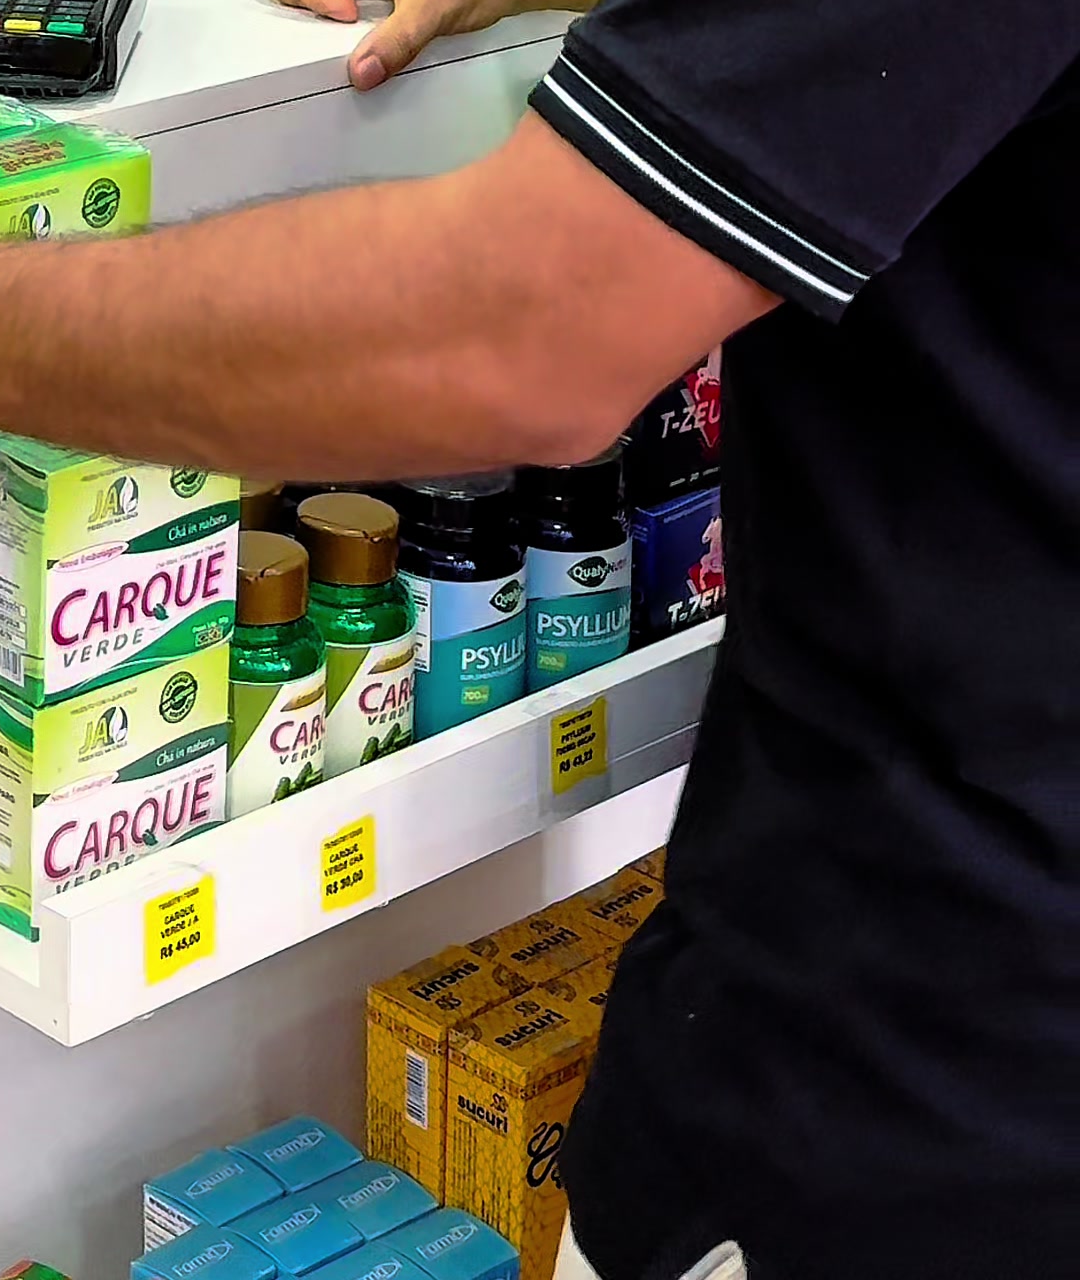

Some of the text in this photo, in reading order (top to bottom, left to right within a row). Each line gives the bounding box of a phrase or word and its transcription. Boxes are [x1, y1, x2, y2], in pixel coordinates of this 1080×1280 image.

[51, 550, 225, 647] CARQUE
[536, 603, 632, 638] PSYLLIUM
[62, 627, 145, 669] VERDE
[358, 674, 415, 716] CAR
[270, 713, 326, 755] CAR
[43, 772, 214, 880] CARQUE
[325, 880, 339, 897] R$
[160, 943, 174, 960] R$
[510, 926, 578, 964] sucuri
[494, 1007, 565, 1049] sucuri
[456, 1093, 509, 1134] sucuri
